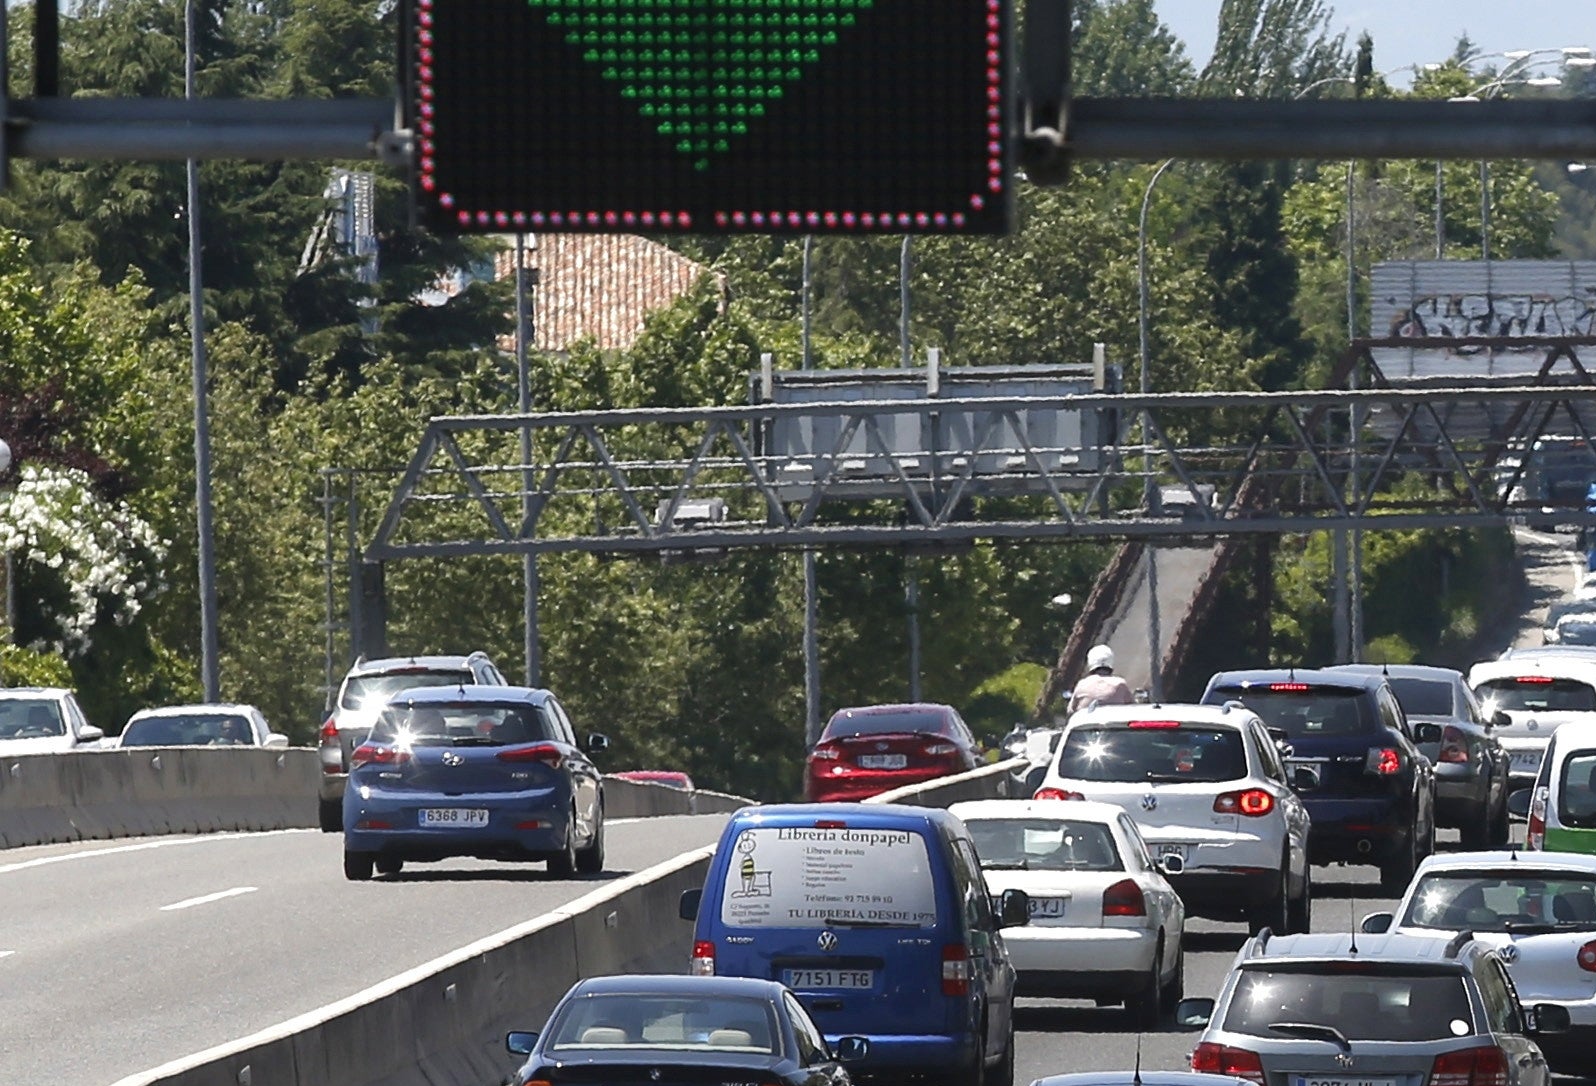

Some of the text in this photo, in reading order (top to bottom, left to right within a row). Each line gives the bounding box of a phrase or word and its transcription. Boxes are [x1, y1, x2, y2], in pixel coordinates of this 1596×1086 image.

[463, 811, 485, 822] JPV
[841, 830, 911, 847] donpapel
[788, 909, 803, 918] TU
[868, 910, 910, 919] DESDE
[793, 971, 869, 987] 7151 FTG
